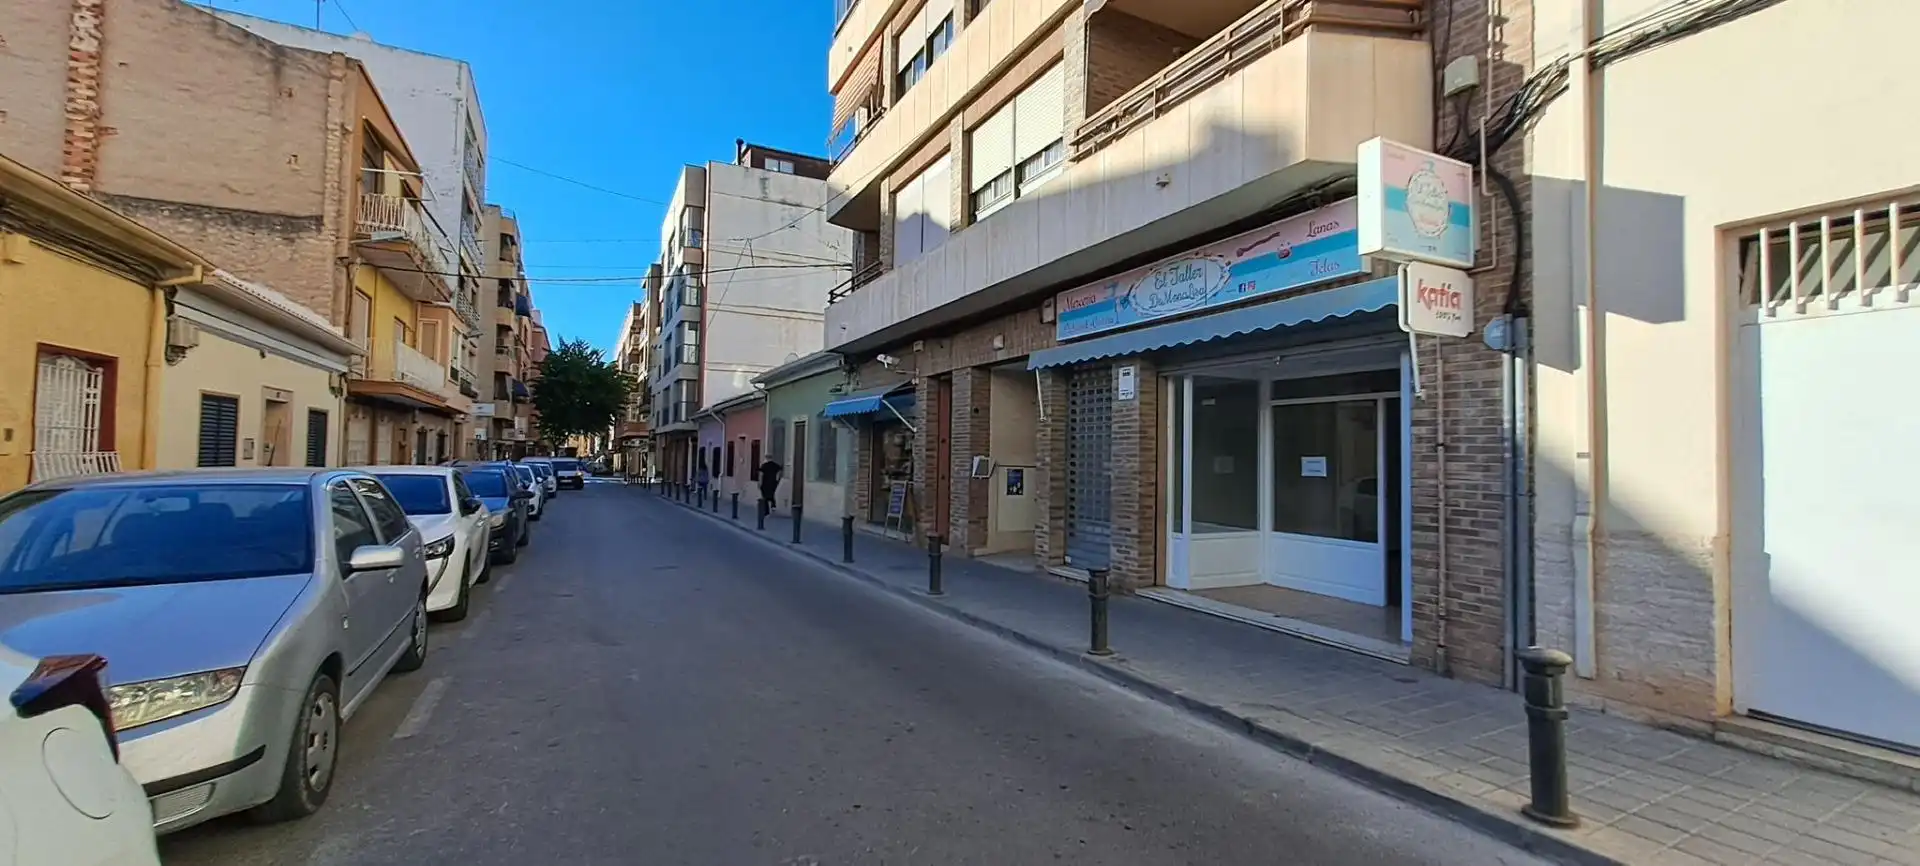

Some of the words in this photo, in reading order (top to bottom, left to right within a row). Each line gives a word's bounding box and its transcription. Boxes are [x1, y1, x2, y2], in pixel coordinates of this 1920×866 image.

[1306, 220, 1340, 238] Lanas
[1154, 271, 1168, 290] El
[1169, 263, 1203, 286] Taller
[1308, 258, 1341, 277] Telas
[1416, 278, 1462, 310] katia
